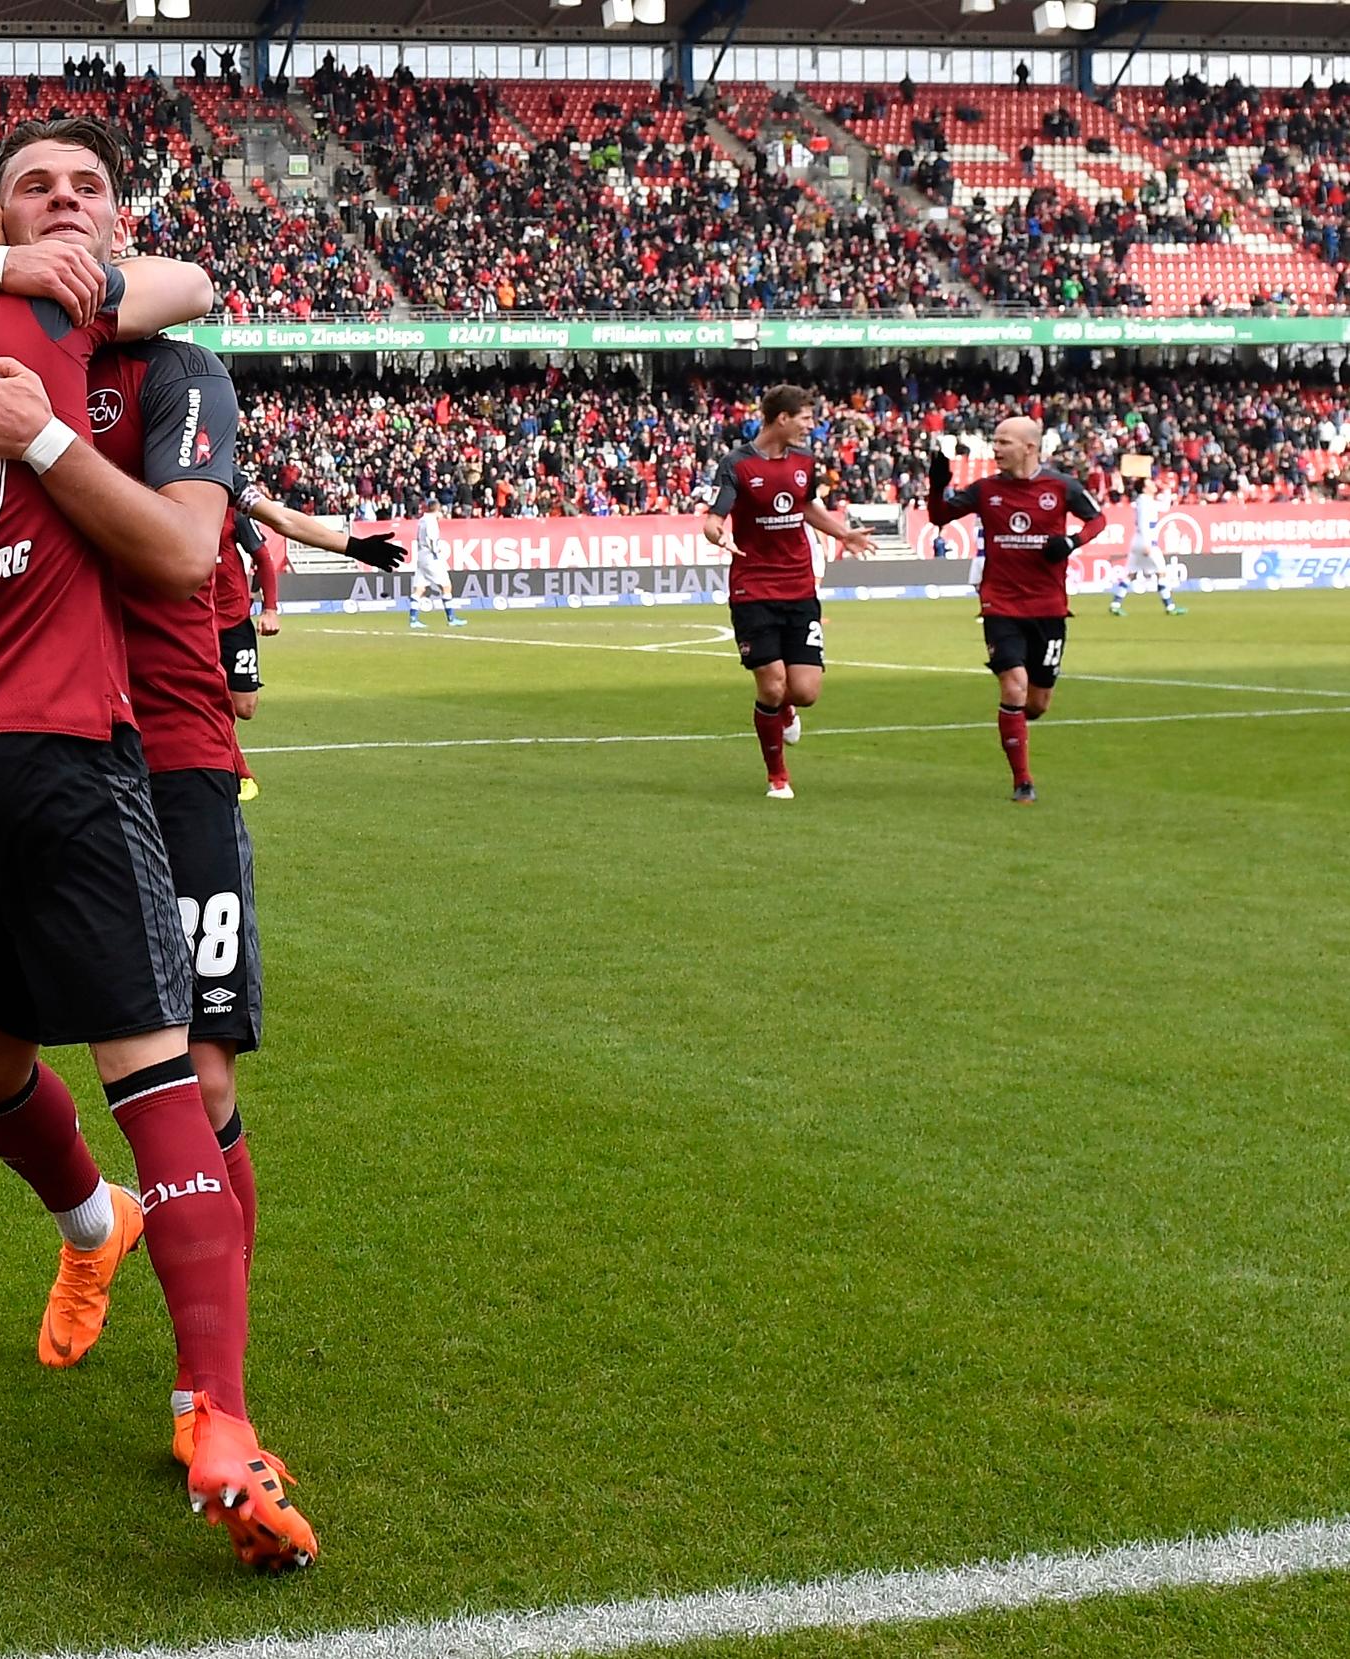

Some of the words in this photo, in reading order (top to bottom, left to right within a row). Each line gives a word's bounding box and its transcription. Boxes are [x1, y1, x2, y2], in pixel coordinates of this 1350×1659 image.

[220, 329, 263, 347] #500
[266, 329, 307, 346] Euro
[310, 327, 425, 348] Zinslos-Dispo
[448, 326, 496, 343] #24/7
[500, 326, 569, 347] Banking
[592, 325, 661, 343] #Filialen
[665, 329, 694, 344] vor
[696, 326, 725, 343] Ort
[557, 533, 733, 568] AIRLINE
[461, 573, 532, 599] AUS
[544, 570, 640, 597] EINER
[203, 1004, 232, 1014] umbro
[141, 1172, 223, 1215] Club
